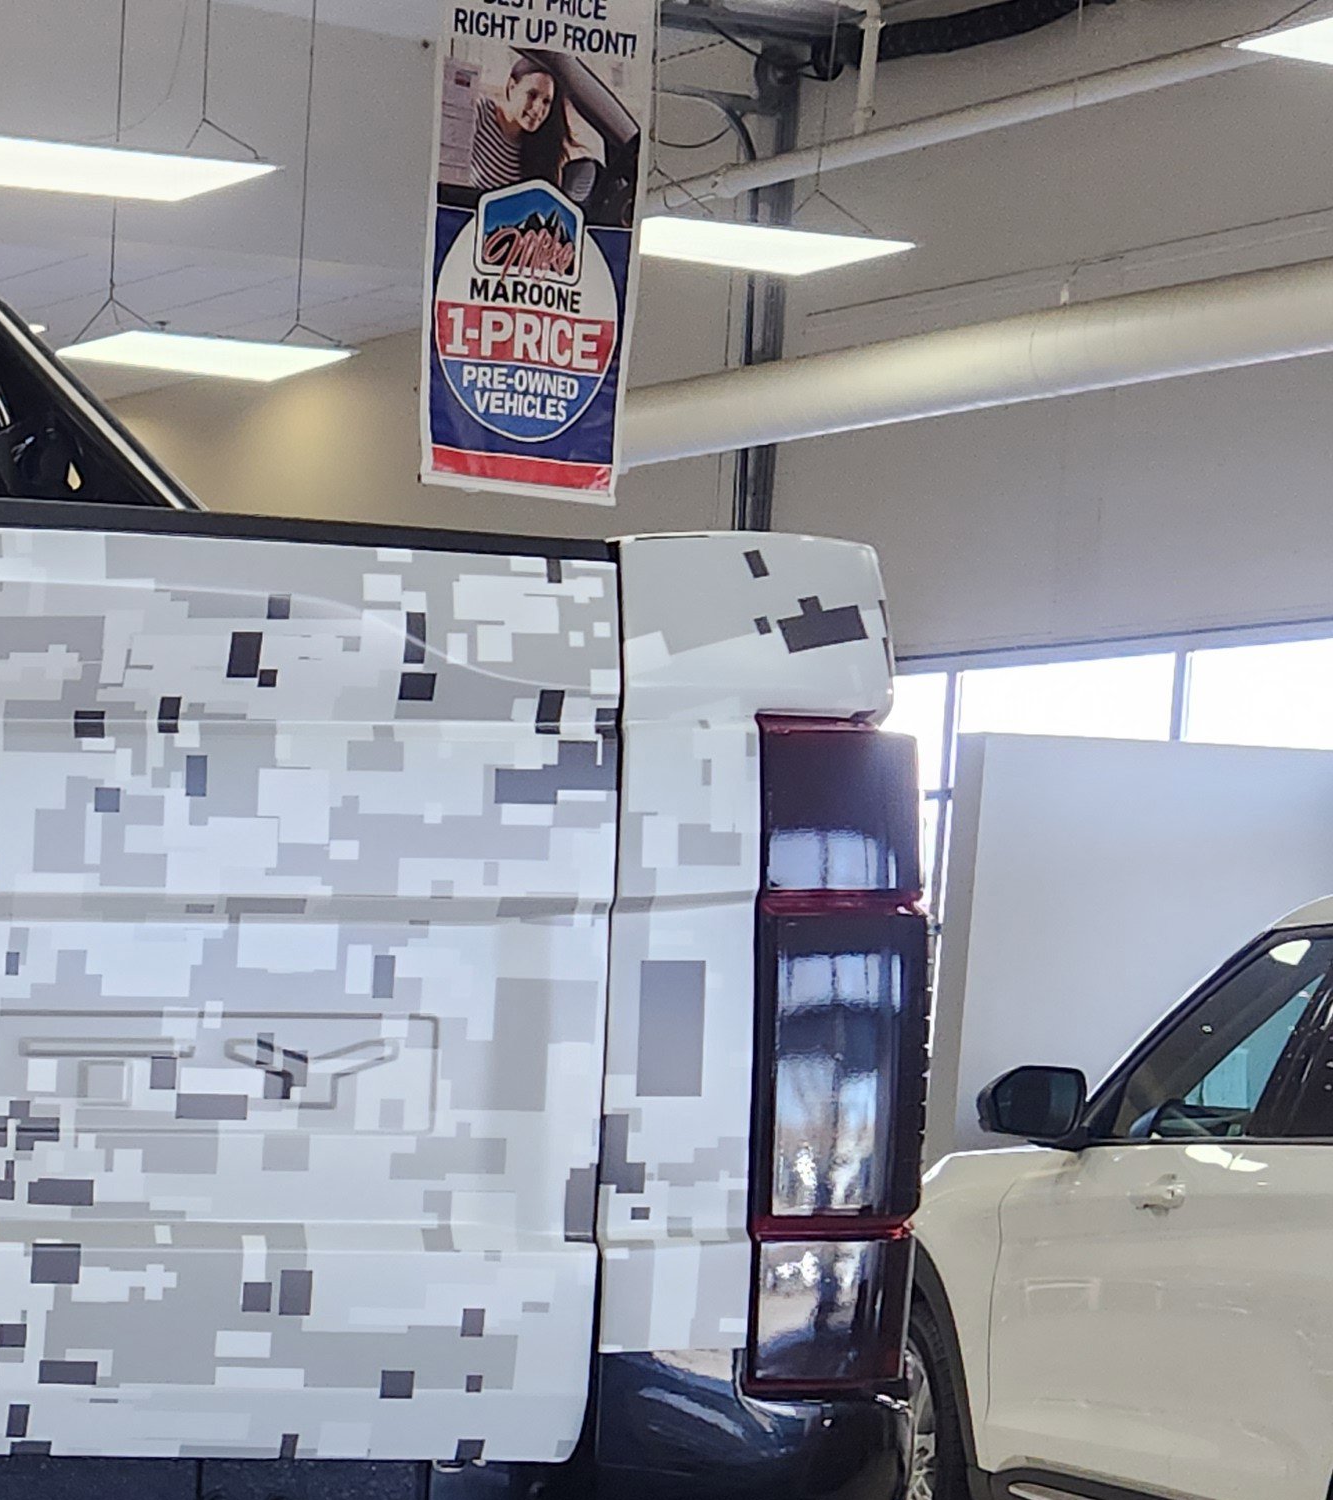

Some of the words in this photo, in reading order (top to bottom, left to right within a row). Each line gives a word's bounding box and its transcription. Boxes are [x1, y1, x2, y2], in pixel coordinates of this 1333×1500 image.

[454, 8, 520, 40] RIGHT
[526, 18, 558, 44] UP
[563, 23, 637, 59] FRONT!
[470, 277, 582, 314] MAROONE
[445, 307, 601, 370] 1-PRICE
[462, 365, 579, 400] PRE-OWNED
[474, 390, 568, 422] VEHICLES
